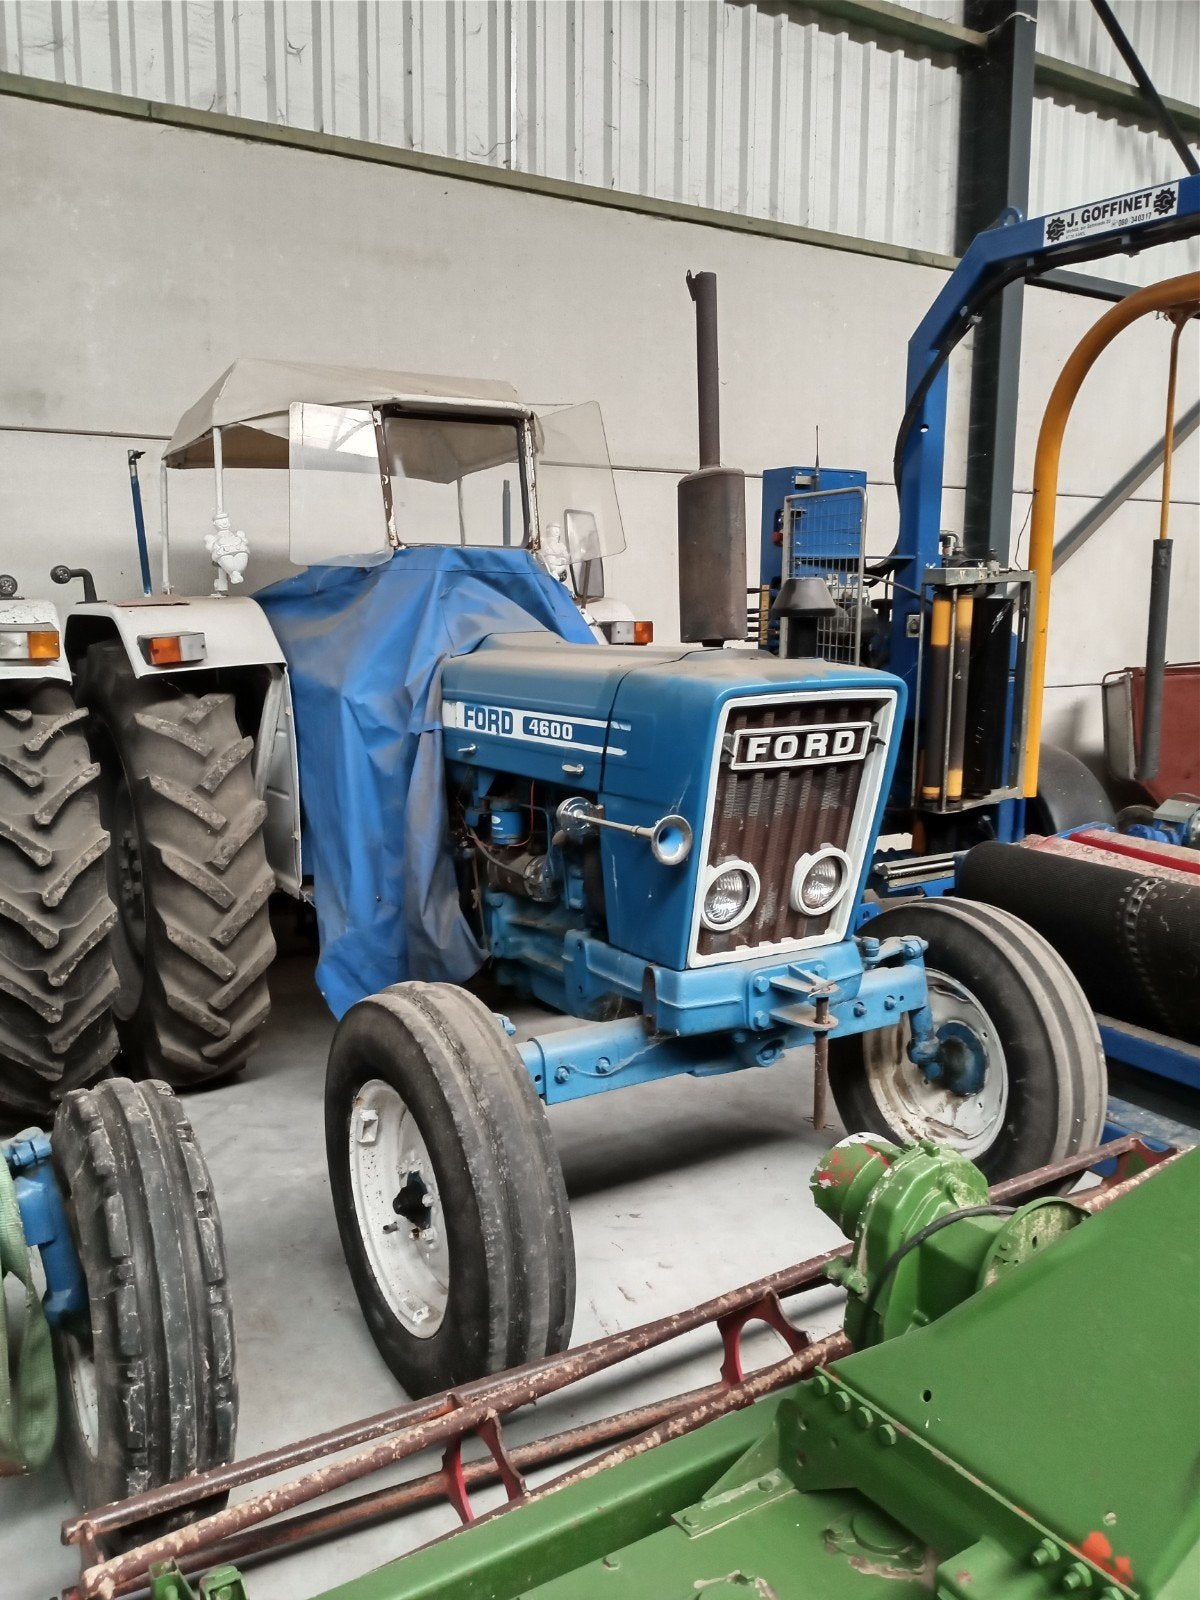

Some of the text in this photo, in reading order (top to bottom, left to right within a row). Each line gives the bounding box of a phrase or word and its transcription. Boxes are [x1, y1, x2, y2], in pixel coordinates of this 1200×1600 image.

[1066, 213, 1079, 228] J.
[1081, 192, 1153, 224] GOFFINET
[463, 705, 574, 741] FORD 4600
[746, 730, 856, 762] FORD
